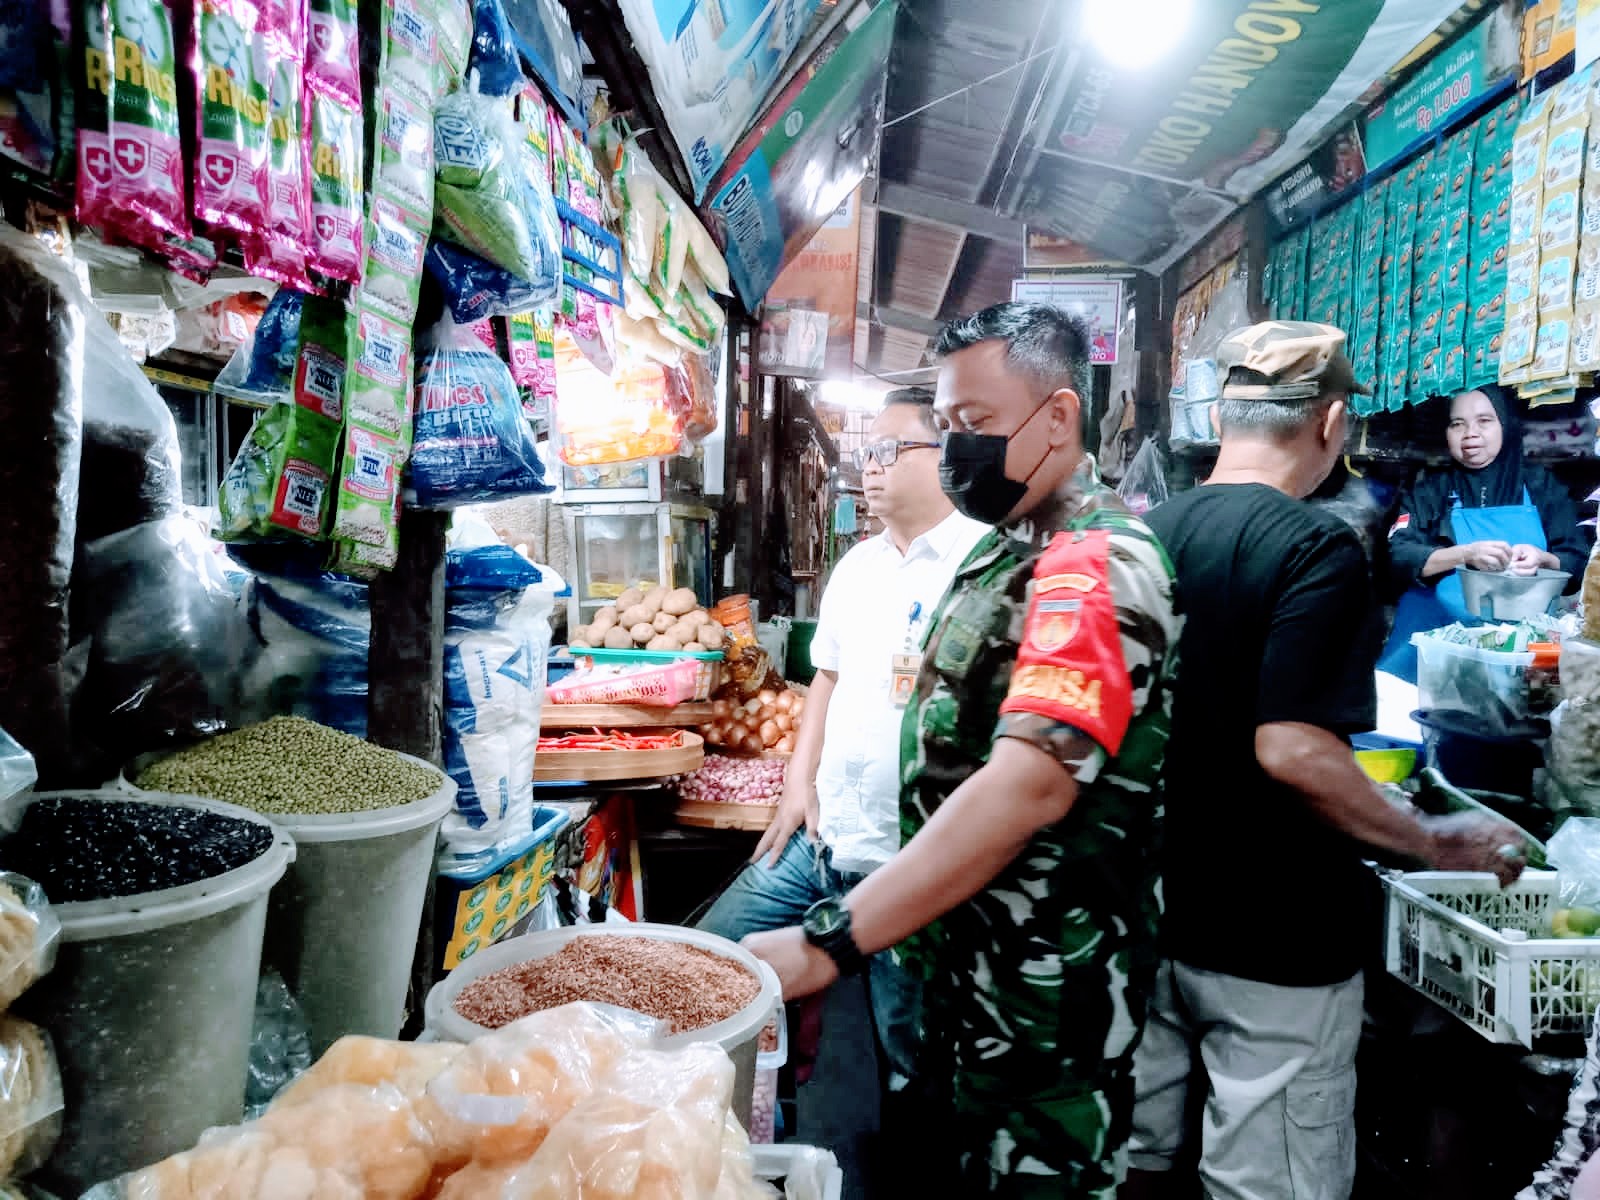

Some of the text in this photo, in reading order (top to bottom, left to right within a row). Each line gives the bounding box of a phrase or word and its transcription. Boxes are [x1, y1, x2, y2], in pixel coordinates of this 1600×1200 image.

[1445, 49, 1474, 80] Mallika
[1416, 106, 1432, 132] Rp
[1434, 72, 1471, 118] 1.000
[1134, 116, 1211, 171] TOKO
